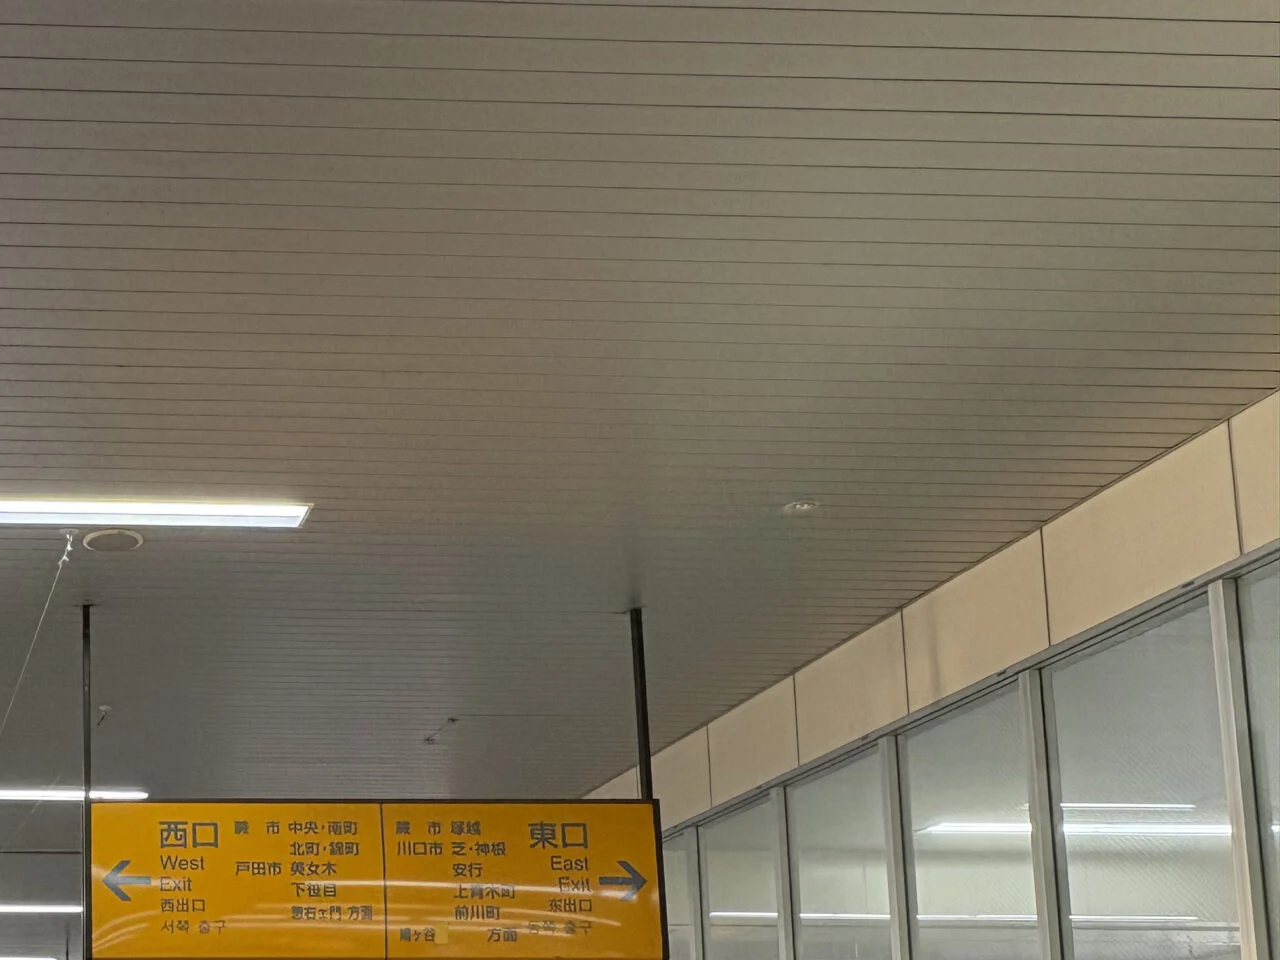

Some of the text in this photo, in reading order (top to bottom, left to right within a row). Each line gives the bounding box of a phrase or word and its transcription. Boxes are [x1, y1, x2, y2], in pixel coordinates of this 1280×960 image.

[158, 820, 219, 849] 西口
[288, 821, 358, 836] 中央・南町
[527, 821, 588, 849] 東口
[397, 842, 443, 857] 川口市
[160, 855, 205, 871] West
[235, 861, 337, 876] 戸田市 美女木
[452, 863, 483, 878] 安行
[551, 855, 589, 871] East
[160, 876, 192, 892] Exit
[558, 876, 590, 892] Exit
[160, 898, 205, 912] 西出口
[454, 905, 501, 921] 前川町
[548, 898, 592, 912] 東出口
[487, 927, 518, 943] 方面
